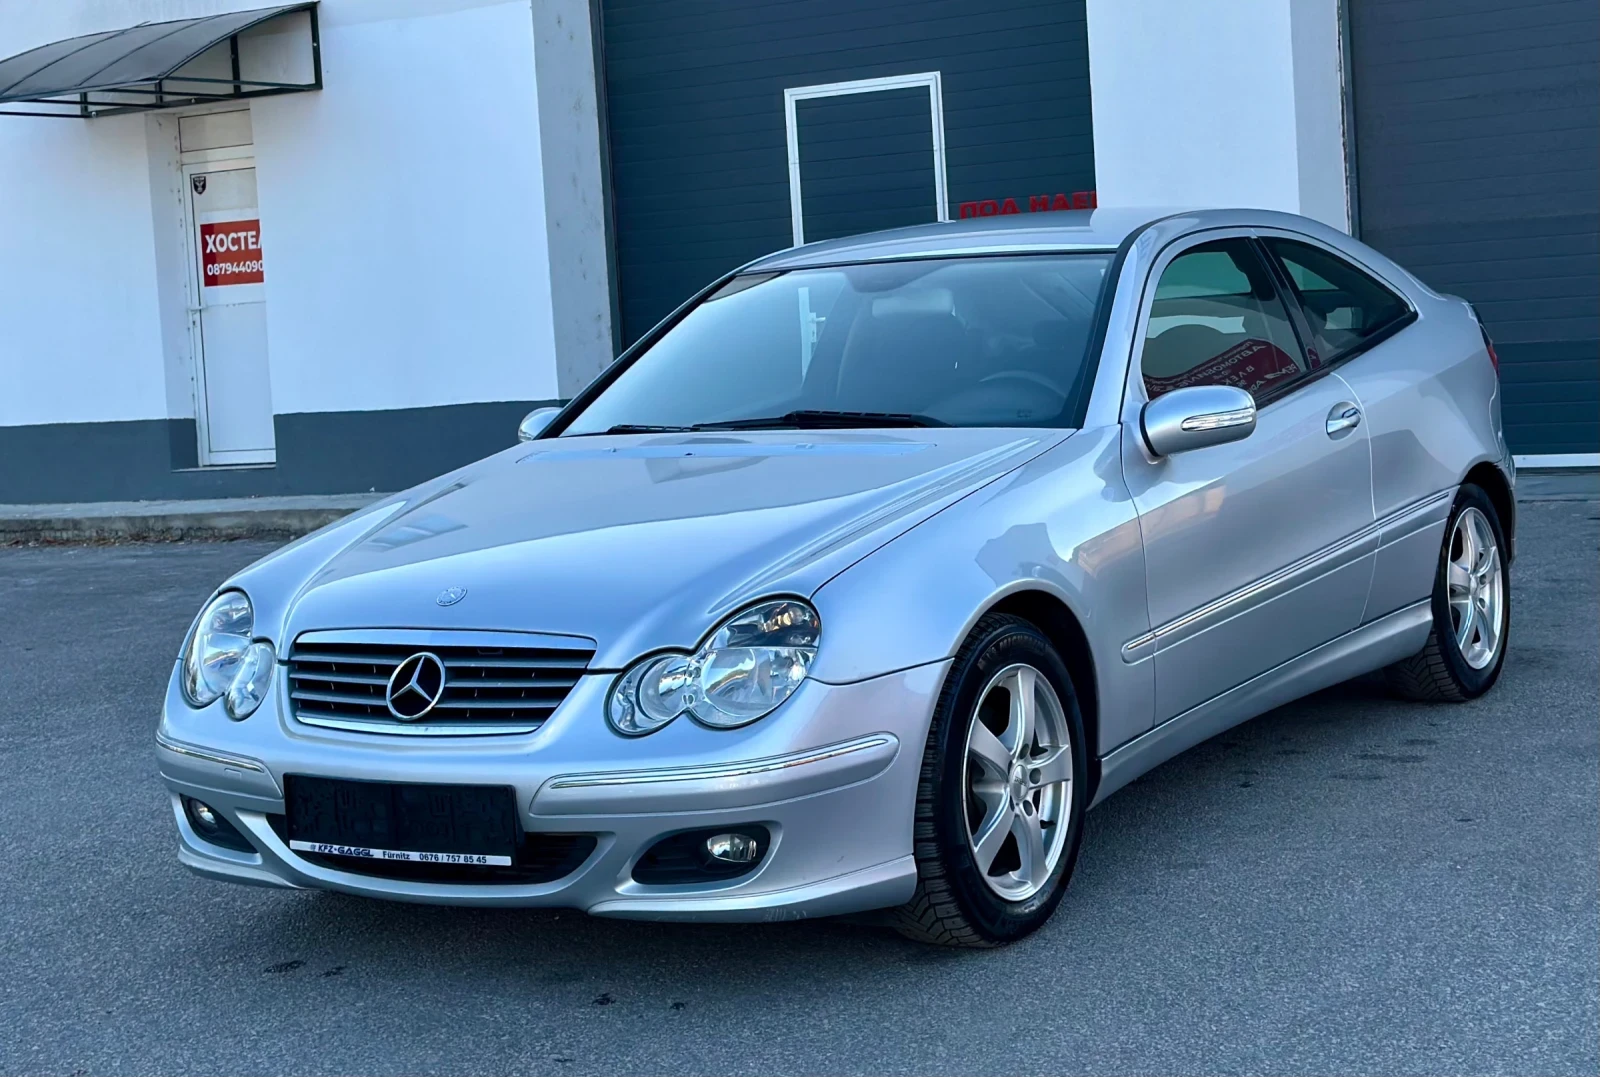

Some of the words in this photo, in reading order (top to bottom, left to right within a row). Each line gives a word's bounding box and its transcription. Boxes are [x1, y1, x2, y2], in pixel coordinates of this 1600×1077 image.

[1029, 191, 1097, 213] НАЕ
[382, 850, 410, 860] Fürnitz
[419, 852, 440, 862] 0676
[446, 854, 460, 863] 757
[463, 855, 474, 863] 85
[476, 855, 487, 864] 45
